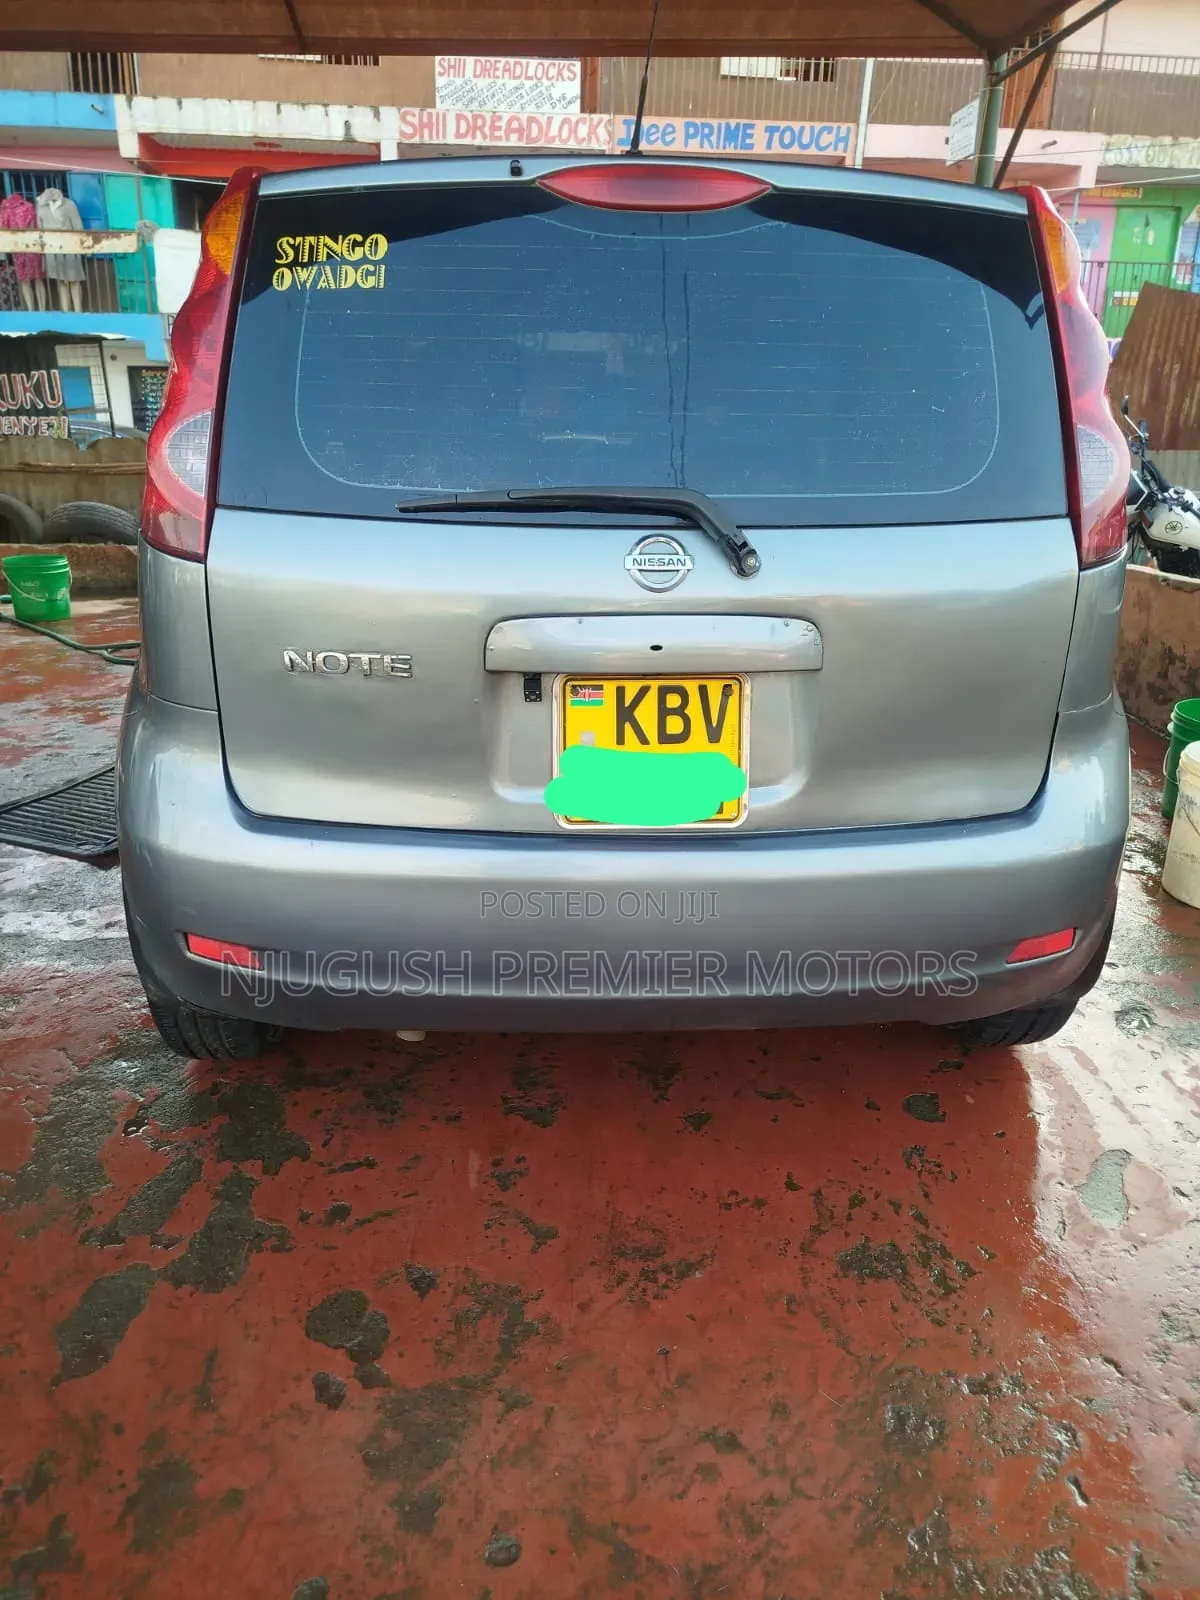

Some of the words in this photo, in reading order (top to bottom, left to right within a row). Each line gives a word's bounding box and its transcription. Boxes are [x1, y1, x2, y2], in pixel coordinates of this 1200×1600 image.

[438, 57, 466, 78] SHII
[473, 59, 577, 82] DREADLOCKS
[400, 109, 447, 142] SHII
[454, 112, 613, 146] DREADLOCKS
[683, 121, 755, 150] PRIME
[764, 124, 850, 152] TOUCH
[275, 233, 388, 264] STINGO
[272, 264, 386, 291] OWADGI
[0, 369, 63, 412] UKU
[0, 415, 68, 439] ENYEJI
[632, 557, 686, 567] NISSAN
[283, 649, 413, 678] NOTE
[615, 684, 732, 746] KBV
